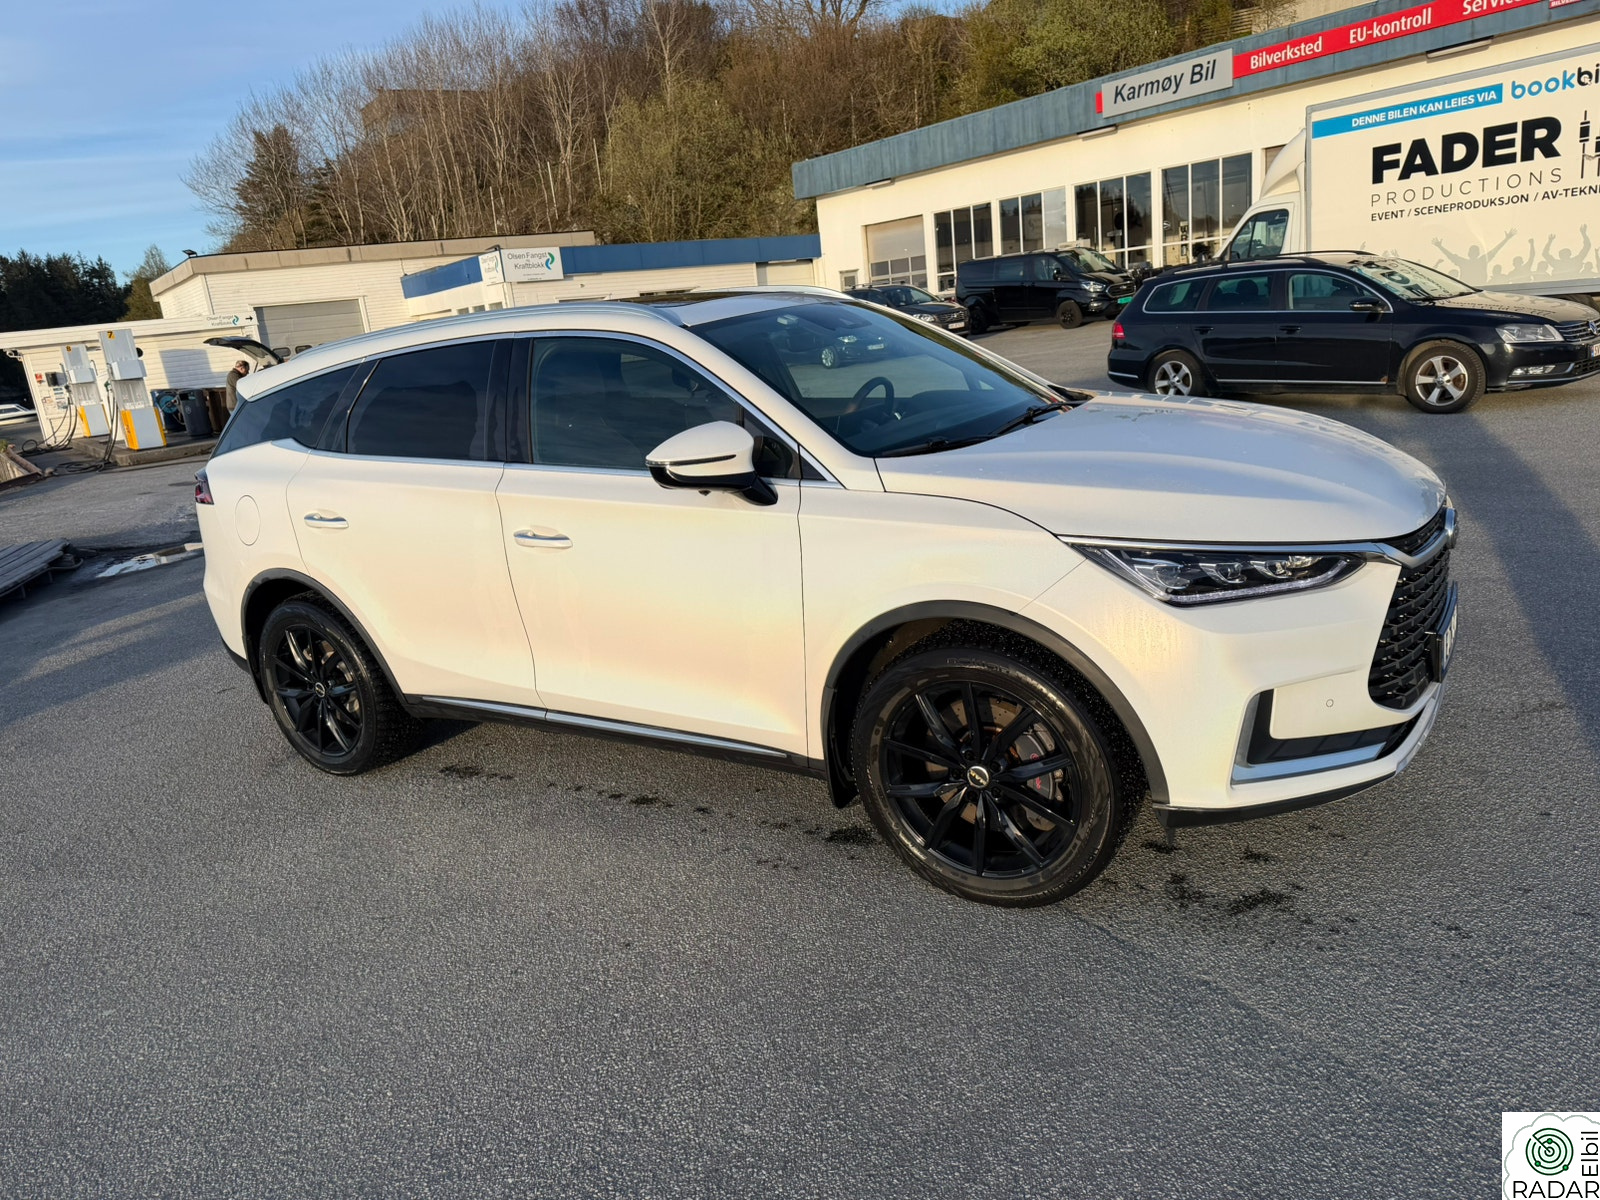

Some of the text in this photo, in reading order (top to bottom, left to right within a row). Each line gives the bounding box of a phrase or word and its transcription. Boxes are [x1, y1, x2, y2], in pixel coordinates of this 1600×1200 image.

[1462, 0, 1522, 15] Serv
[1349, 7, 1432, 44] EU-kontroll
[1250, 36, 1323, 70] Bilverksted
[1113, 59, 1216, 104] Karmøy Bil
[1511, 63, 1600, 99] bookbi
[1352, 91, 1497, 128] DENNE BILEN KAN LEIES VIA
[1372, 116, 1562, 185] FADER
[1370, 168, 1562, 207] PRODUCTIONS
[1370, 209, 1406, 222] EVENT
[1414, 194, 1529, 216] SCENEPRODUKSJON
[514, 262, 545, 270] Kraftblokk
[526, 252, 548, 260] Fangst
[107, 330, 112, 338] 7
